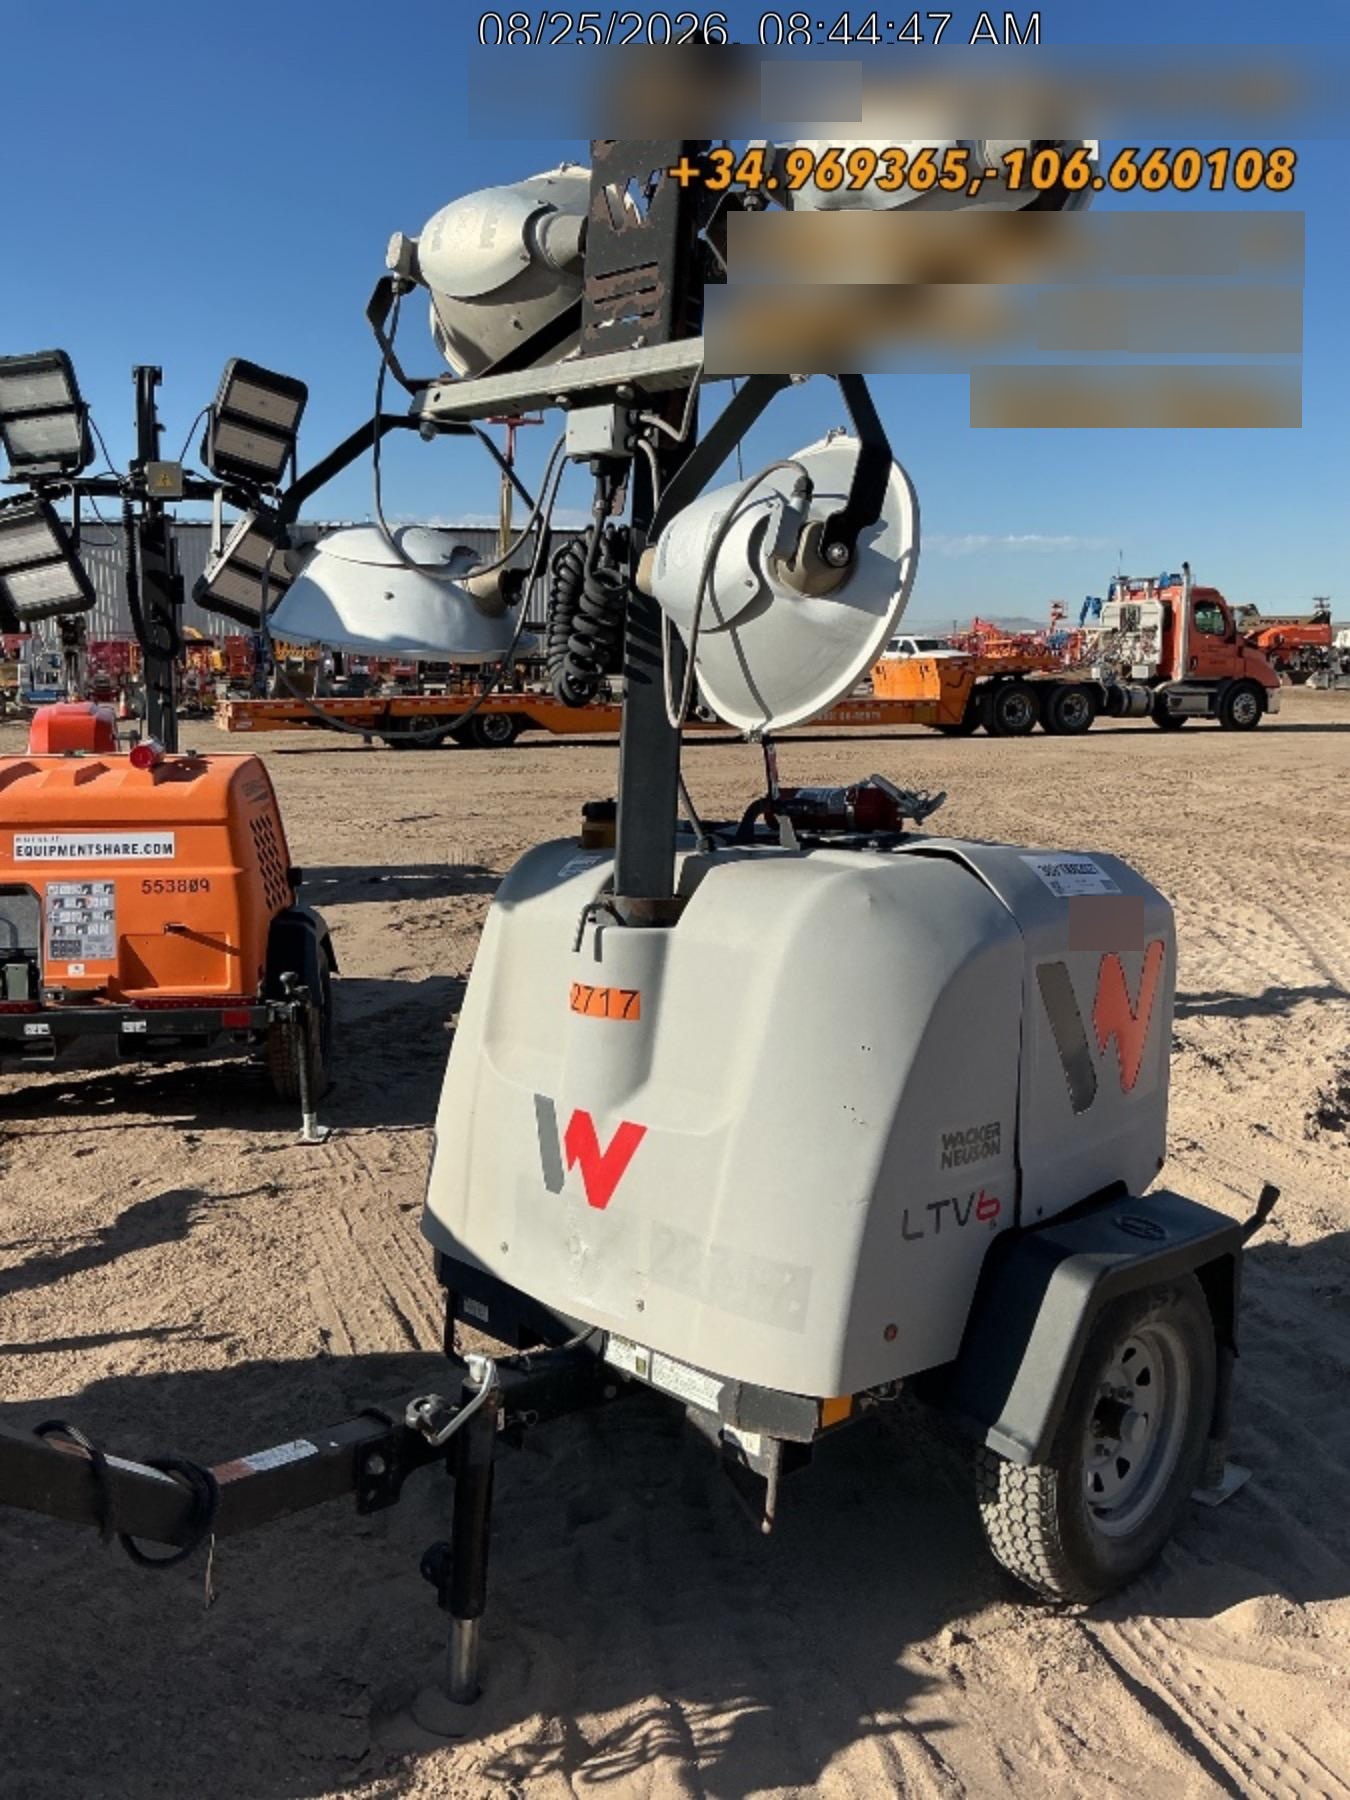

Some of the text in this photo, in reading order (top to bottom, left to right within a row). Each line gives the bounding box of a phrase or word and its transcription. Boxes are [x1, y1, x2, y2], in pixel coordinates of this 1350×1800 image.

[15, 843, 173, 857] EQUIPMENTSHARE.COM
[570, 983, 639, 1018] 2717
[902, 1189, 1001, 1240] LTV6
